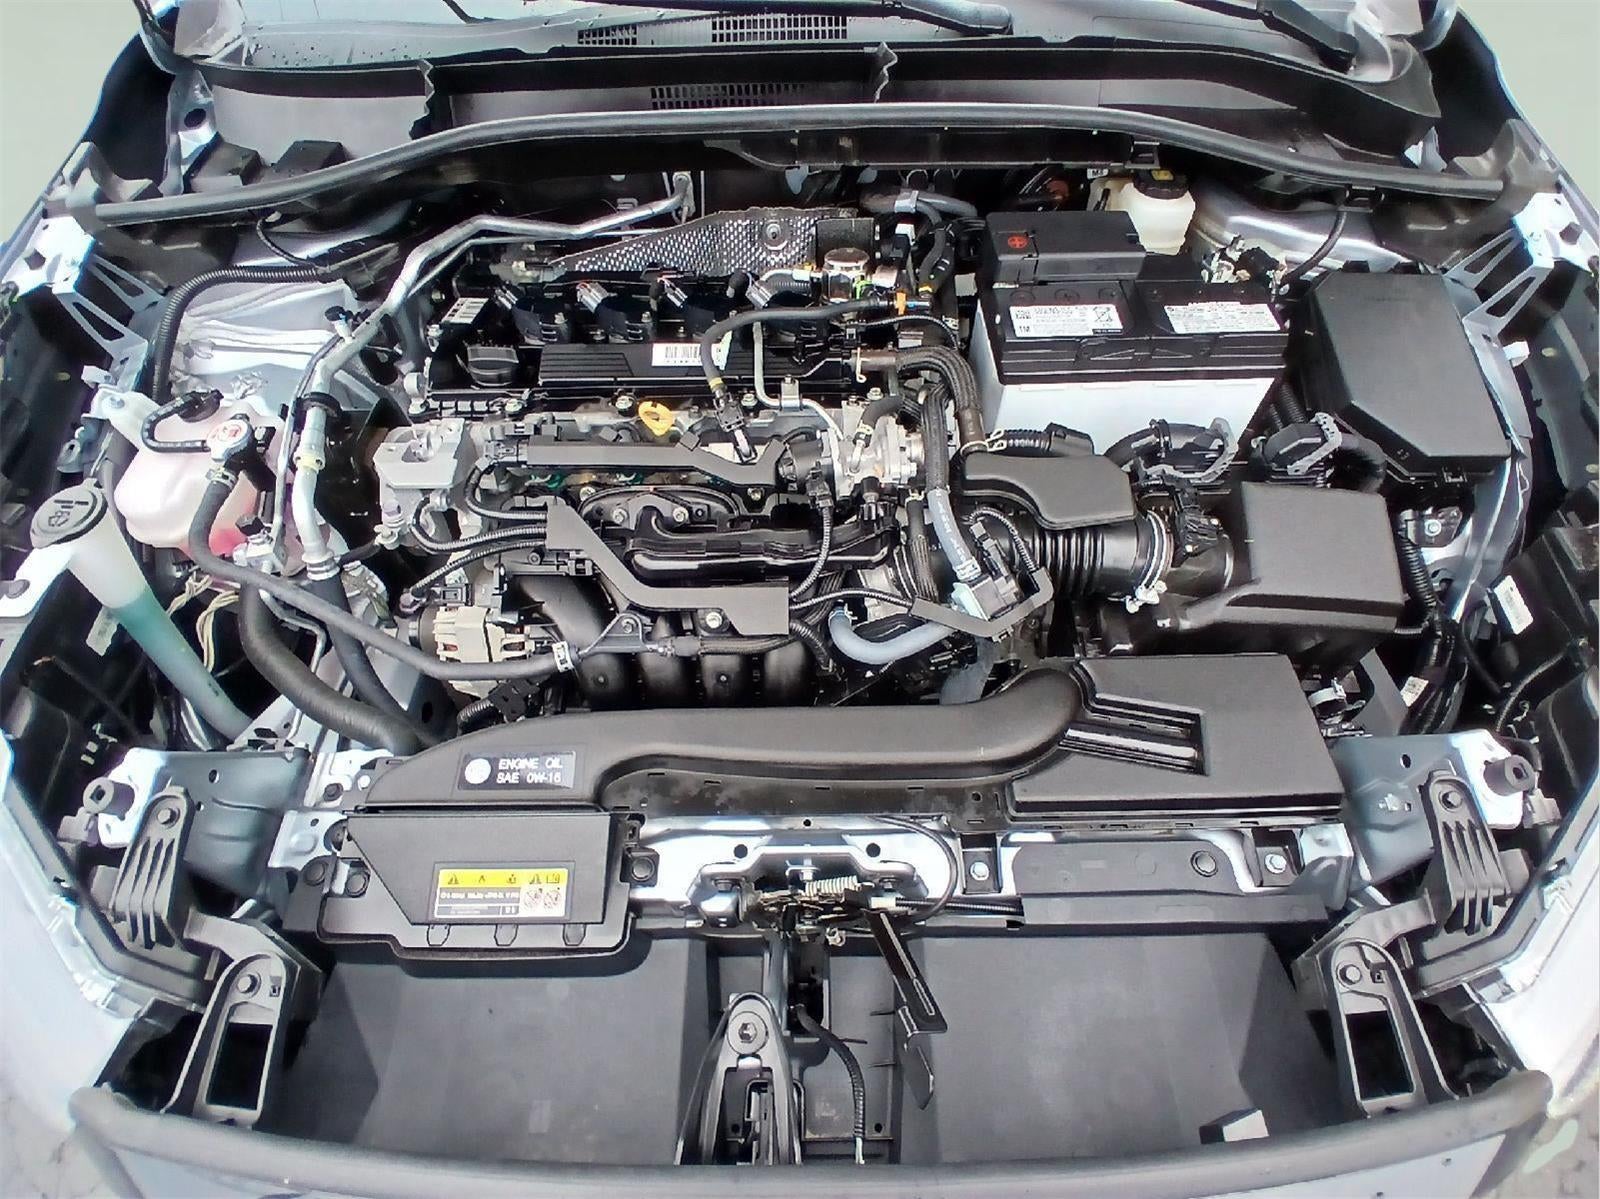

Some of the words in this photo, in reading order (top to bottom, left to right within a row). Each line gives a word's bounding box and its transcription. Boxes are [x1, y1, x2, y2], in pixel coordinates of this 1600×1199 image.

[498, 758, 539, 770] ENGINE
[545, 757, 563, 769] OIL
[496, 772, 520, 784] SAE
[526, 772, 562, 784] 0W-16
